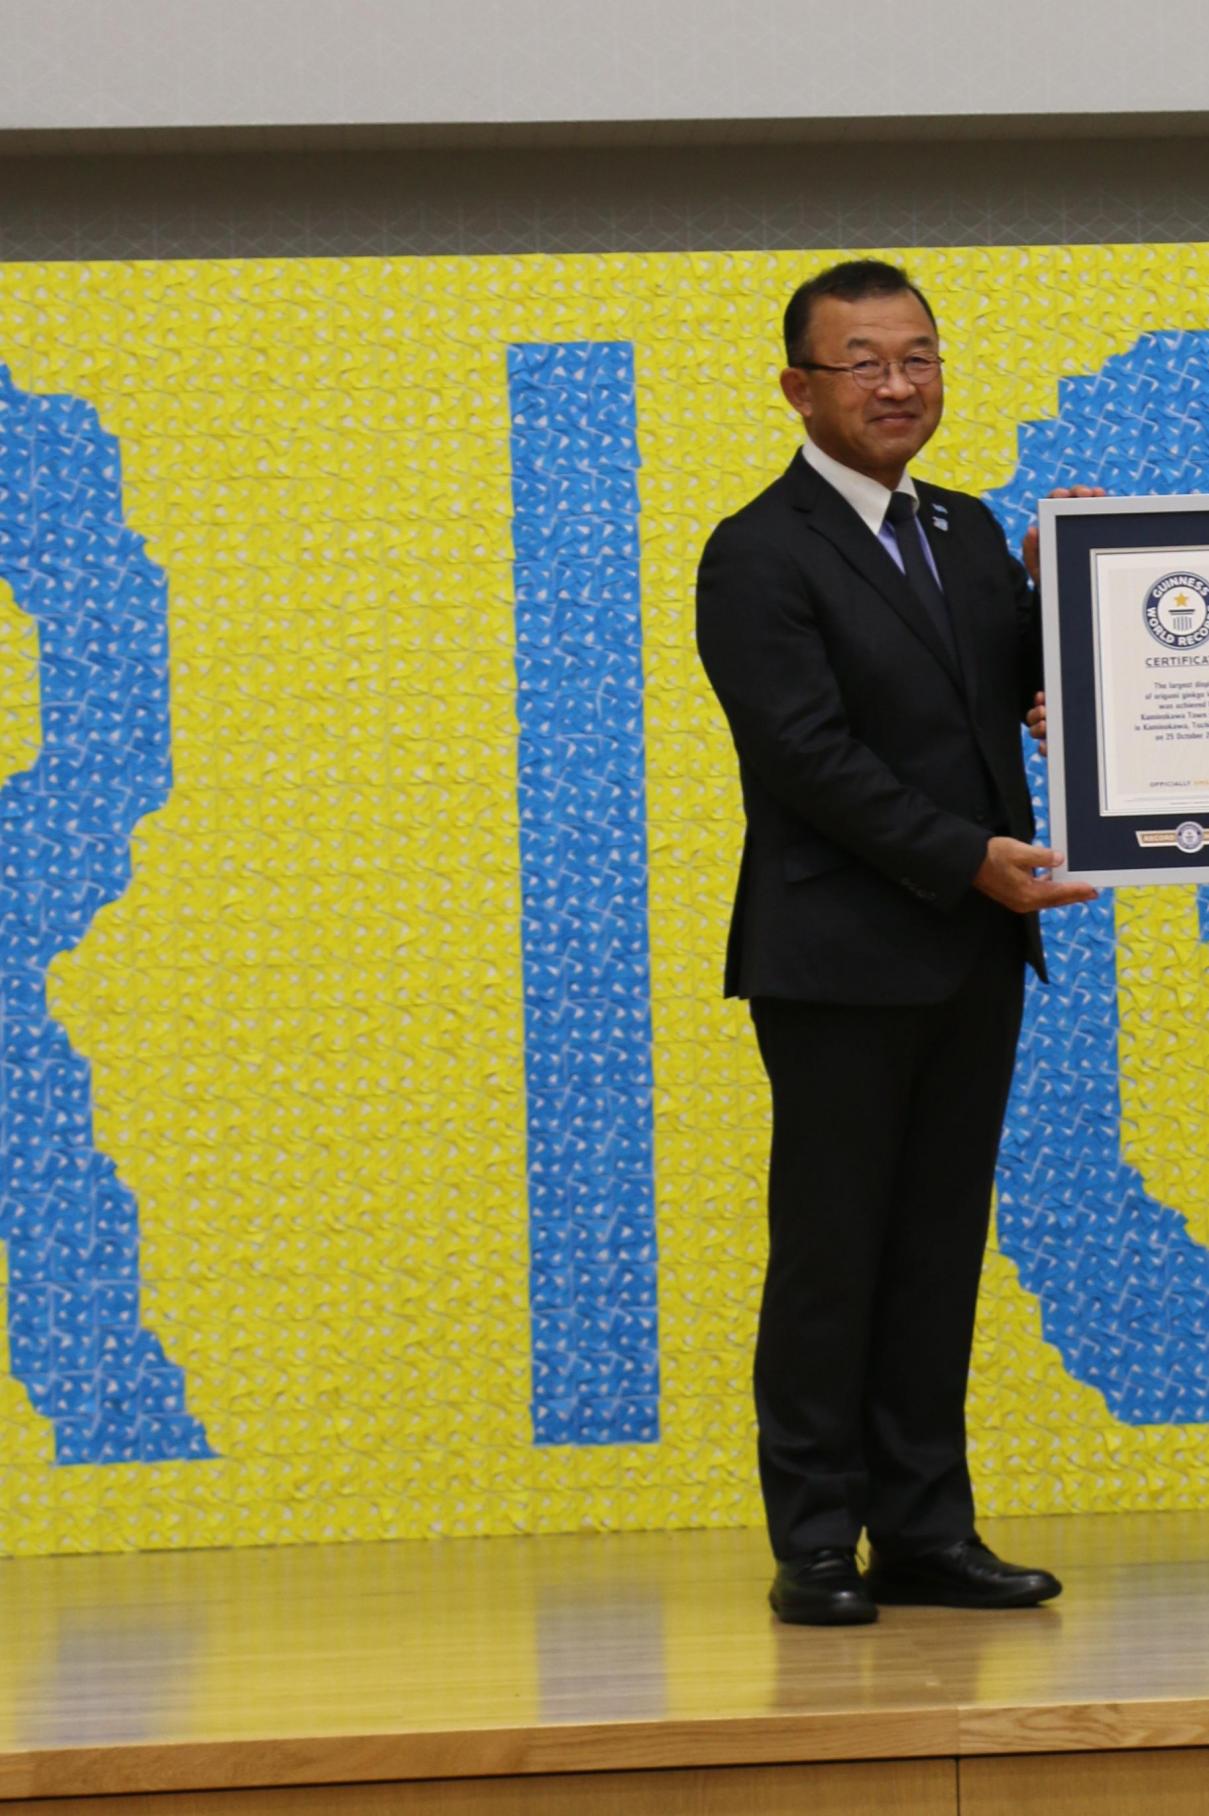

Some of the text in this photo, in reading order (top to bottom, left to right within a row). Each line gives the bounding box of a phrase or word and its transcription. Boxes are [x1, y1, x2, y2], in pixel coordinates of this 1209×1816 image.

[1153, 576, 1209, 599] GUINNESS
[1146, 606, 1176, 645] WORLD
[1169, 682, 1193, 690] largest
[1154, 692, 1179, 701] origami
[1182, 692, 1205, 700] ginkgo
[1176, 732, 1202, 740] October
[1149, 780, 1190, 788] OFFICIALLY
